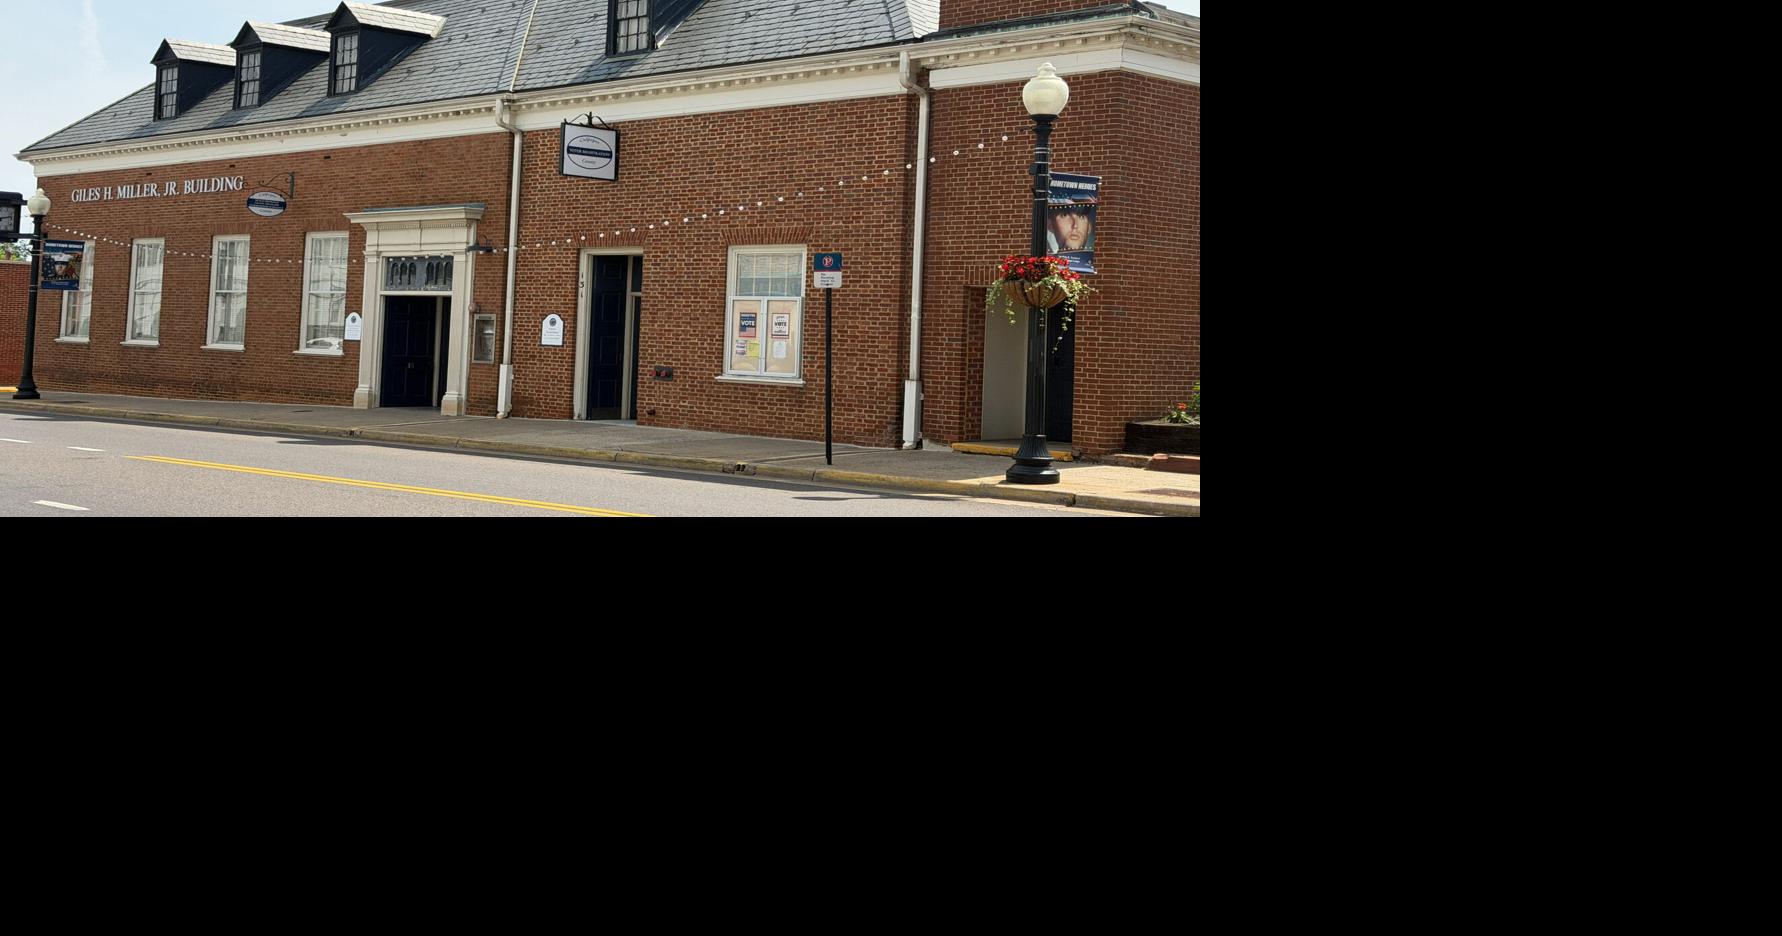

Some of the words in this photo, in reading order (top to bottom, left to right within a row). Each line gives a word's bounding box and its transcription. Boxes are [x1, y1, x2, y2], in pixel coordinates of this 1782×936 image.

[71, 187, 100, 203] GILES
[103, 186, 113, 200] H.
[117, 183, 161, 198] MILLER,
[163, 181, 180, 196] JR.
[184, 175, 244, 195] BUILDING
[1050, 180, 1078, 190] HOMETOWN
[1078, 182, 1097, 191] HEROES
